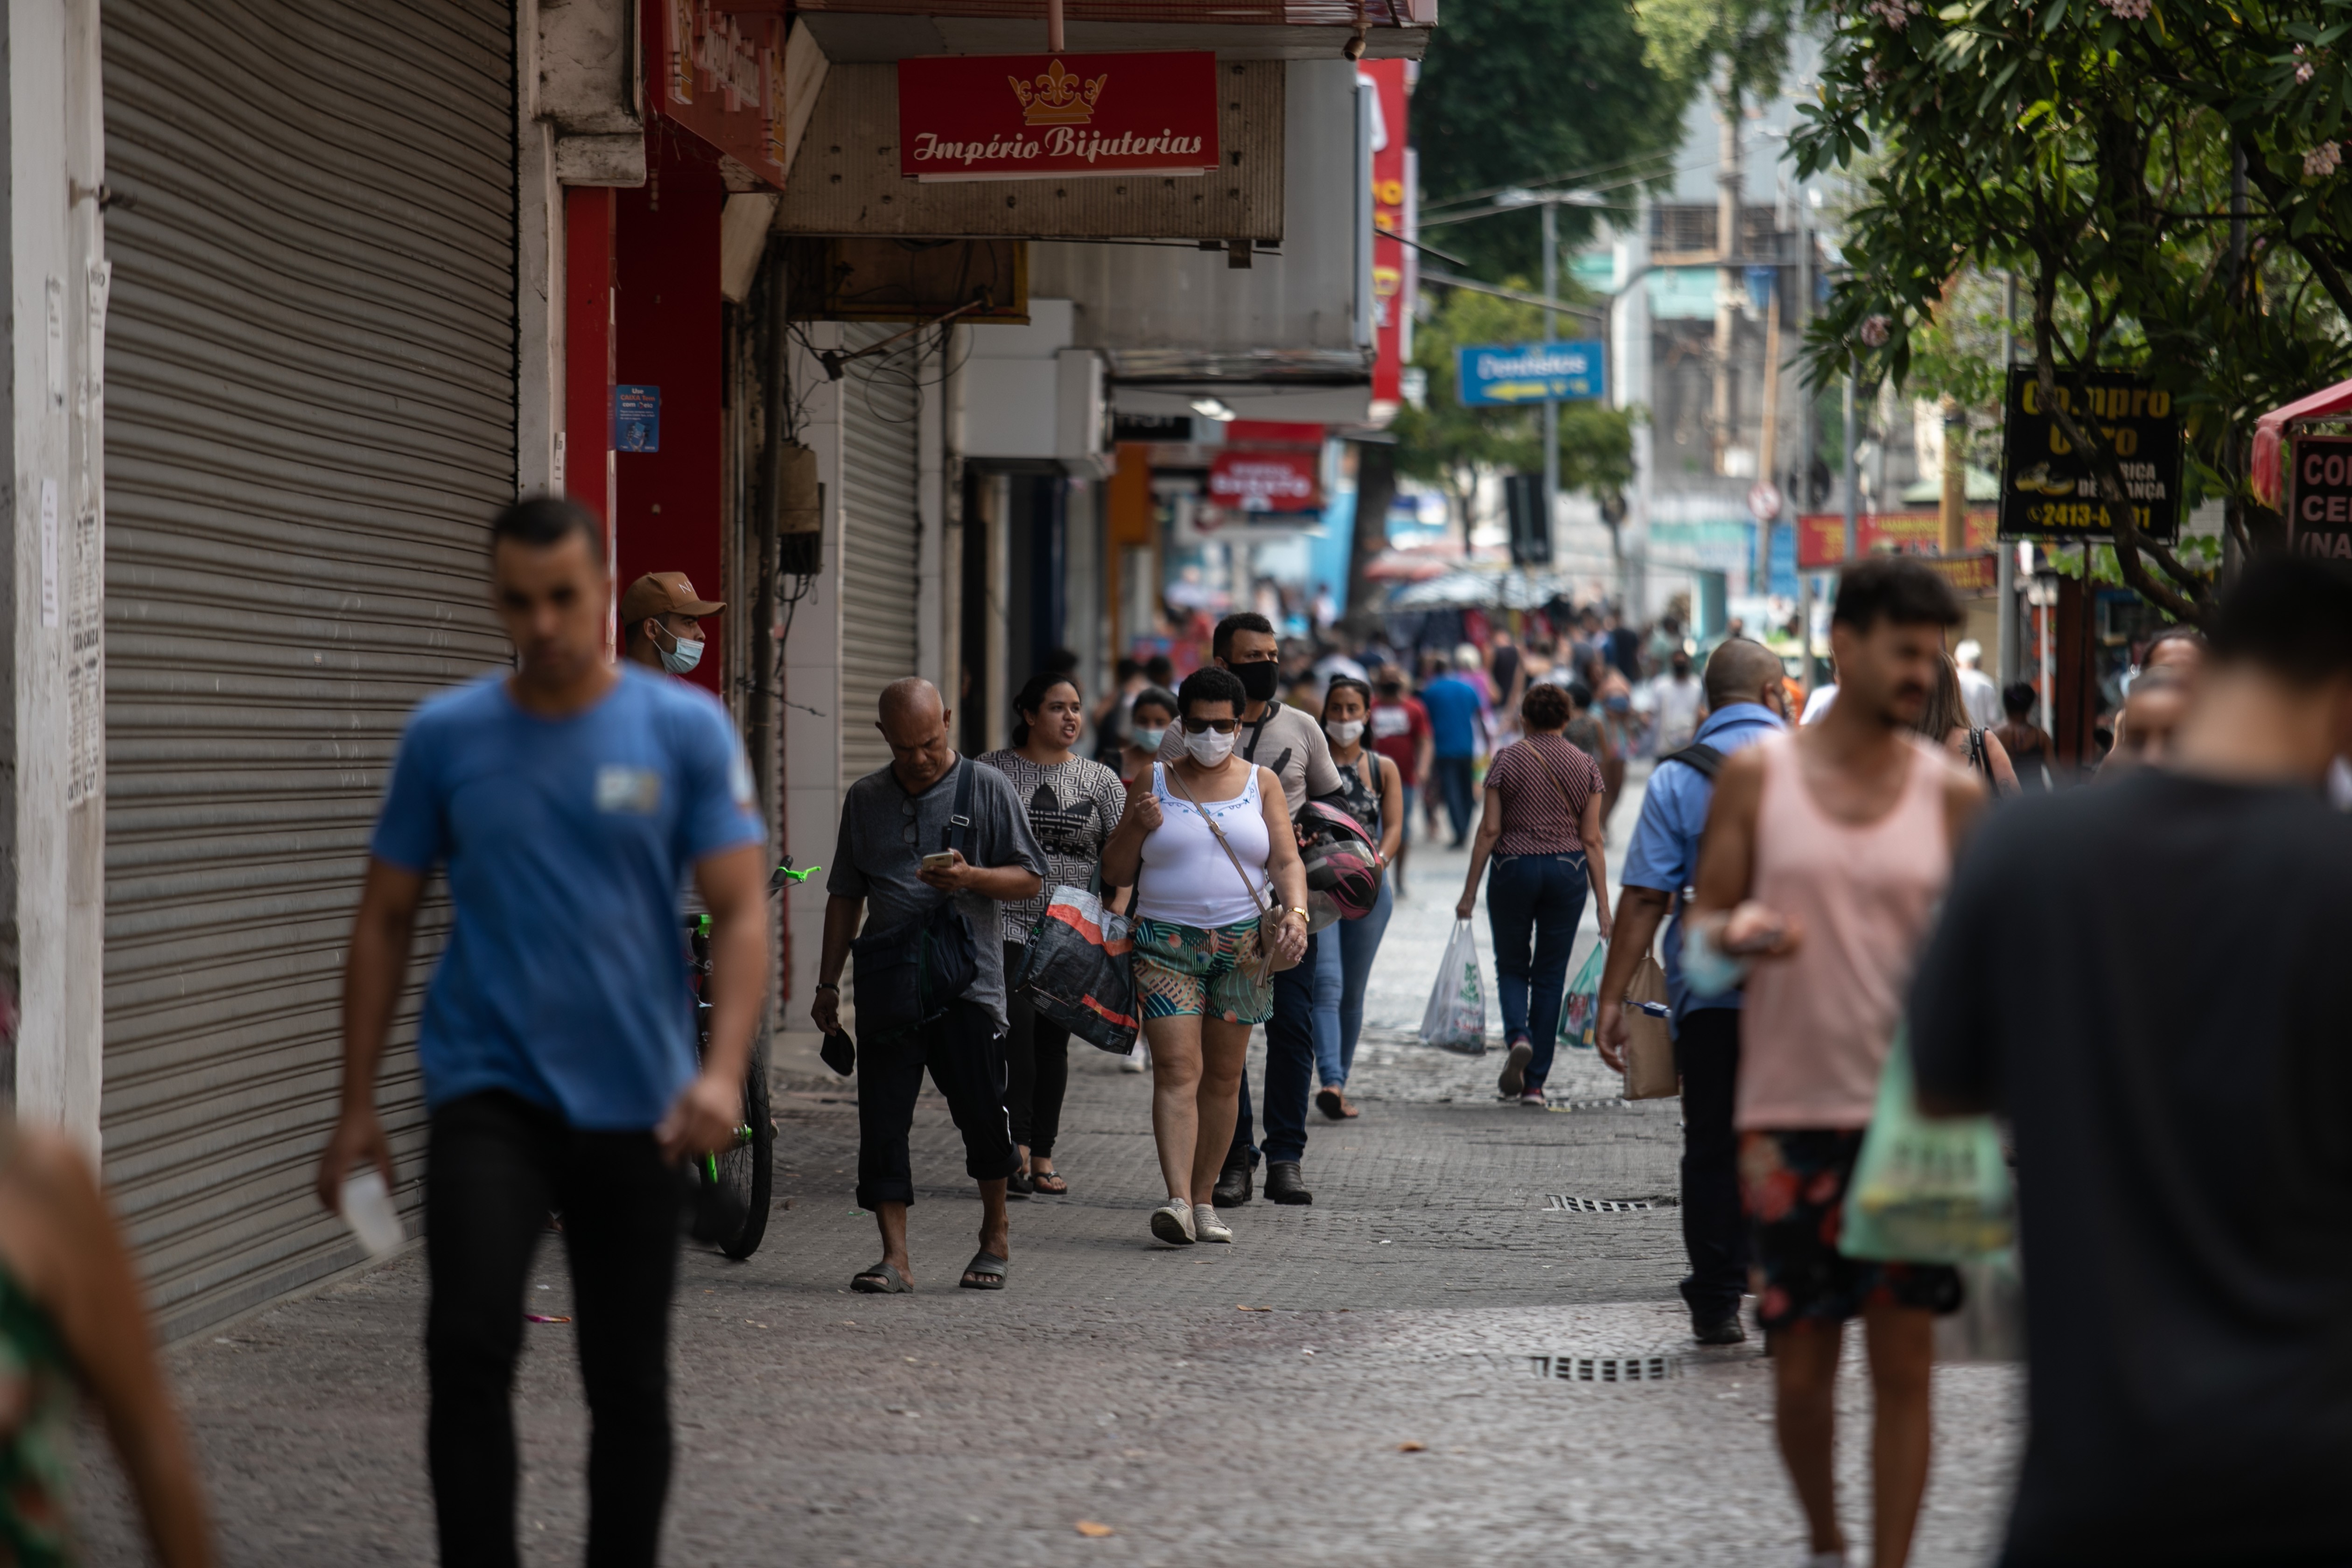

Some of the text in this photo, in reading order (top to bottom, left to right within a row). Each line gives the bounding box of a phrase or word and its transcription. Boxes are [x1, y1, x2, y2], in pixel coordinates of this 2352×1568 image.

[913, 126, 1203, 165] Império Bijuterias
[2303, 454, 2352, 486] CO
[2077, 478, 2098, 498] DE
[2302, 495, 2352, 522] CE
